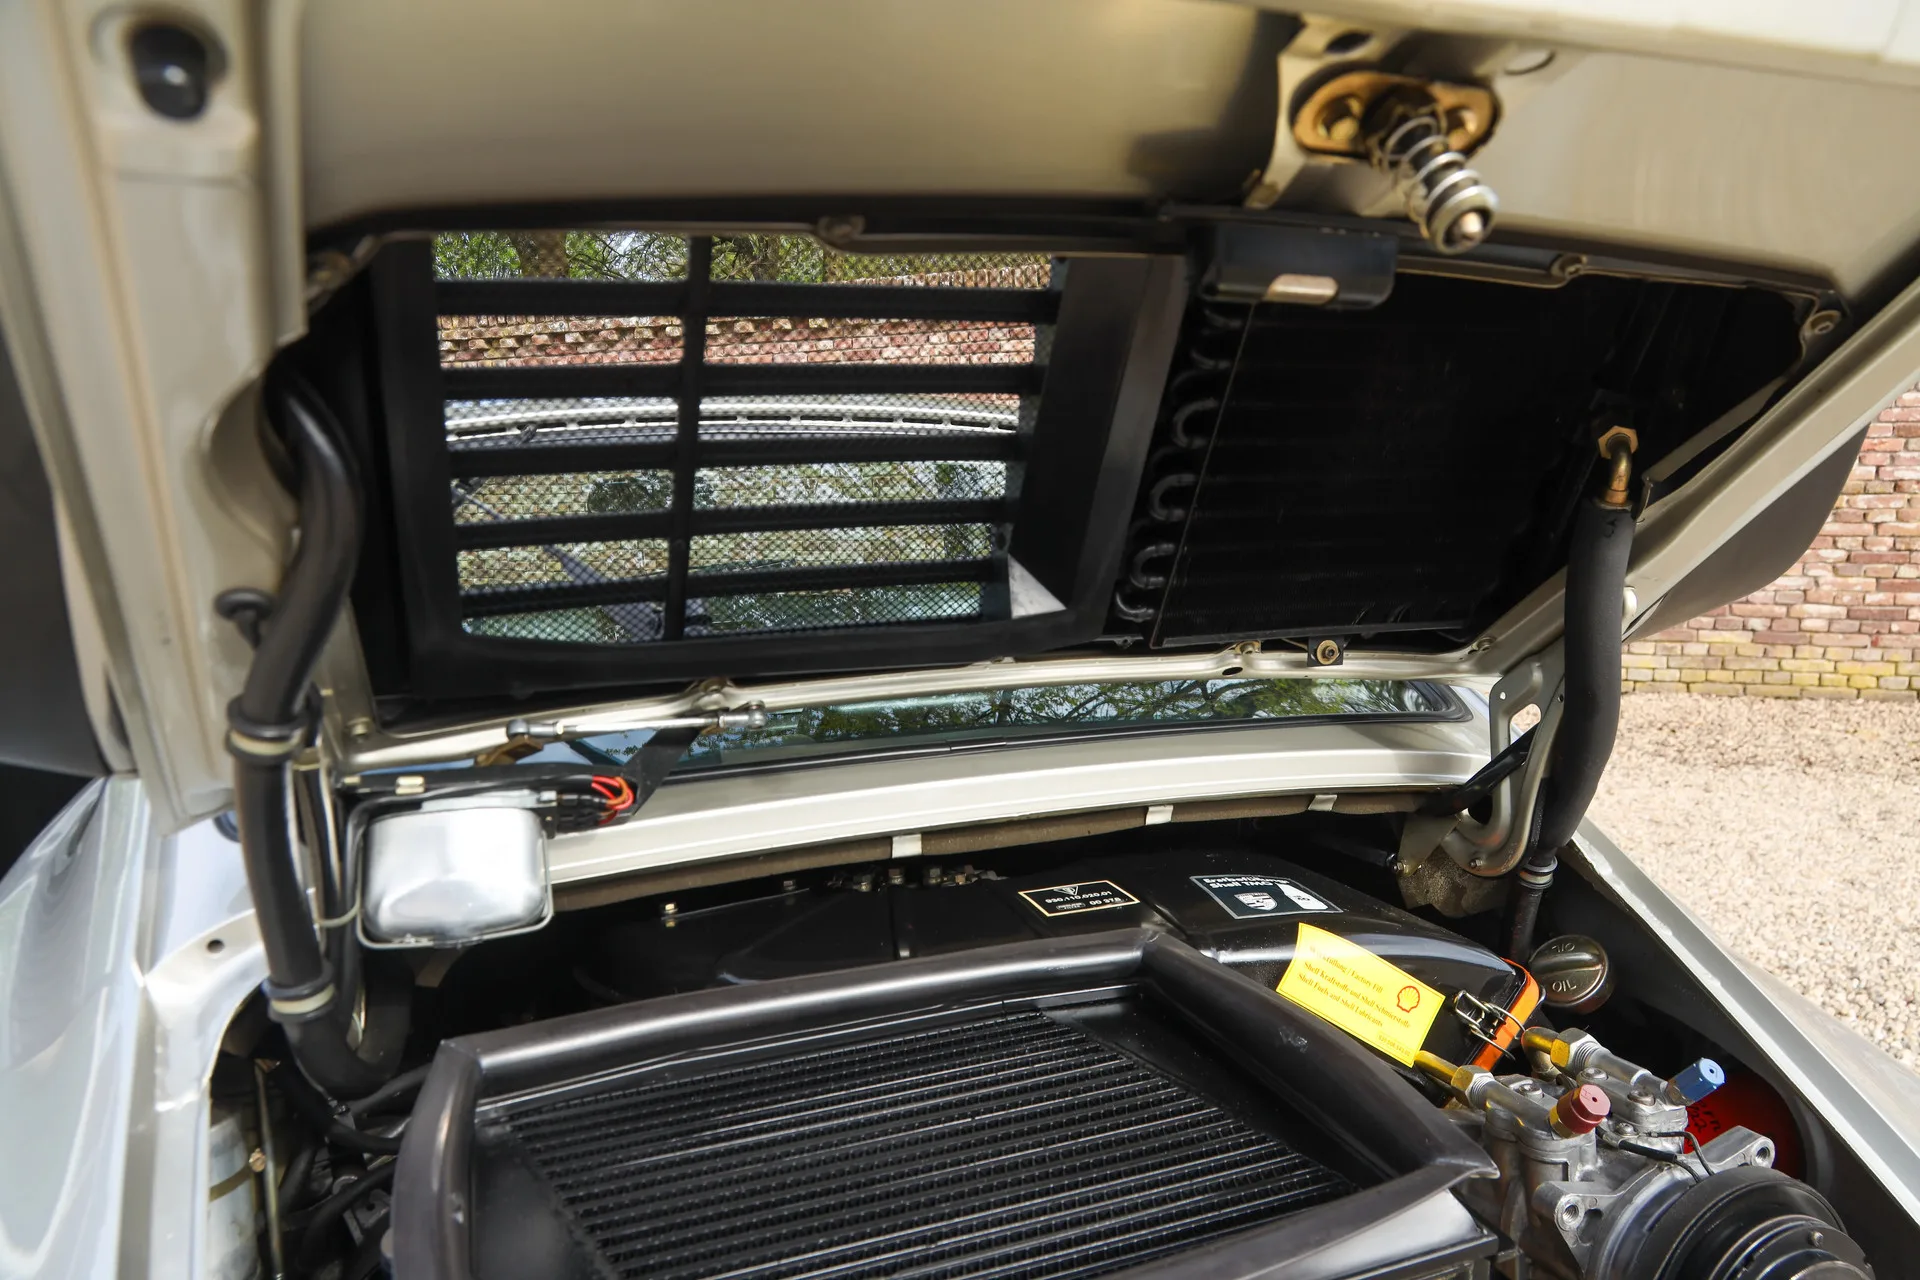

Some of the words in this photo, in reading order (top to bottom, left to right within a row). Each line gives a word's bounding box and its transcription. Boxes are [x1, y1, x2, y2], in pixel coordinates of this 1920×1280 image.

[1209, 881, 1241, 889] Shell
[1304, 961, 1320, 975] Shell
[1320, 969, 1350, 992] Kraftstoffe
[1350, 989, 1362, 1000] und
[1361, 995, 1376, 1008] Shell
[1351, 970, 1375, 988] Factory
[1373, 983, 1384, 994] Fill
[1552, 979, 1577, 993] OIL
[1298, 973, 1314, 986] Shell
[1313, 982, 1329, 996] Fuels
[1329, 992, 1342, 1003] and
[1341, 998, 1355, 1010] Shell
[1355, 1003, 1384, 1027] Lubricants
